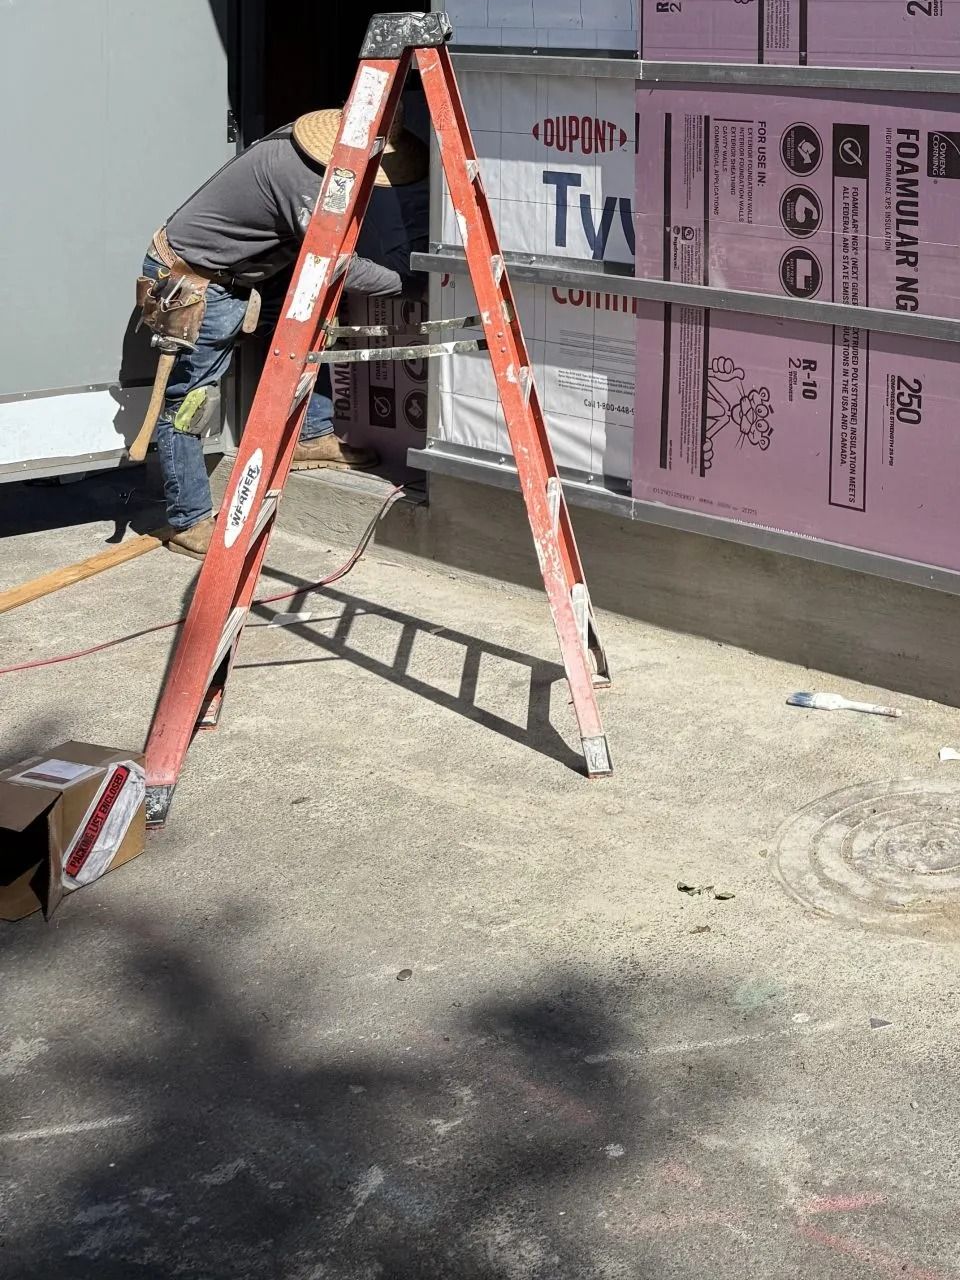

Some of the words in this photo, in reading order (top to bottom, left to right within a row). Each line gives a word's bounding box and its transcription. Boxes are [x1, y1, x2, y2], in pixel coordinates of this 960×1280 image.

[543, 115, 616, 155] DUPONT
[757, 121, 767, 144] FOR
[757, 146, 767, 169] USE
[932, 135, 940, 176] CORNING
[842, 184, 850, 200] ALL
[842, 237, 850, 253] AND
[842, 254, 850, 279] STATE
[802, 358, 818, 400] R-10
[841, 395, 849, 411] USA
[850, 366, 859, 424] POLYSTYRENE)
[895, 375, 923, 425] 250
[841, 412, 849, 430] AND
[840, 431, 848, 467] CANADA.
[849, 426, 858, 477] INSULATION
[849, 477, 857, 503] MEETS
[70, 830, 97, 869] PACKING
[89, 812, 106, 836] LIST
[101, 771, 126, 815] ENCLOSED
